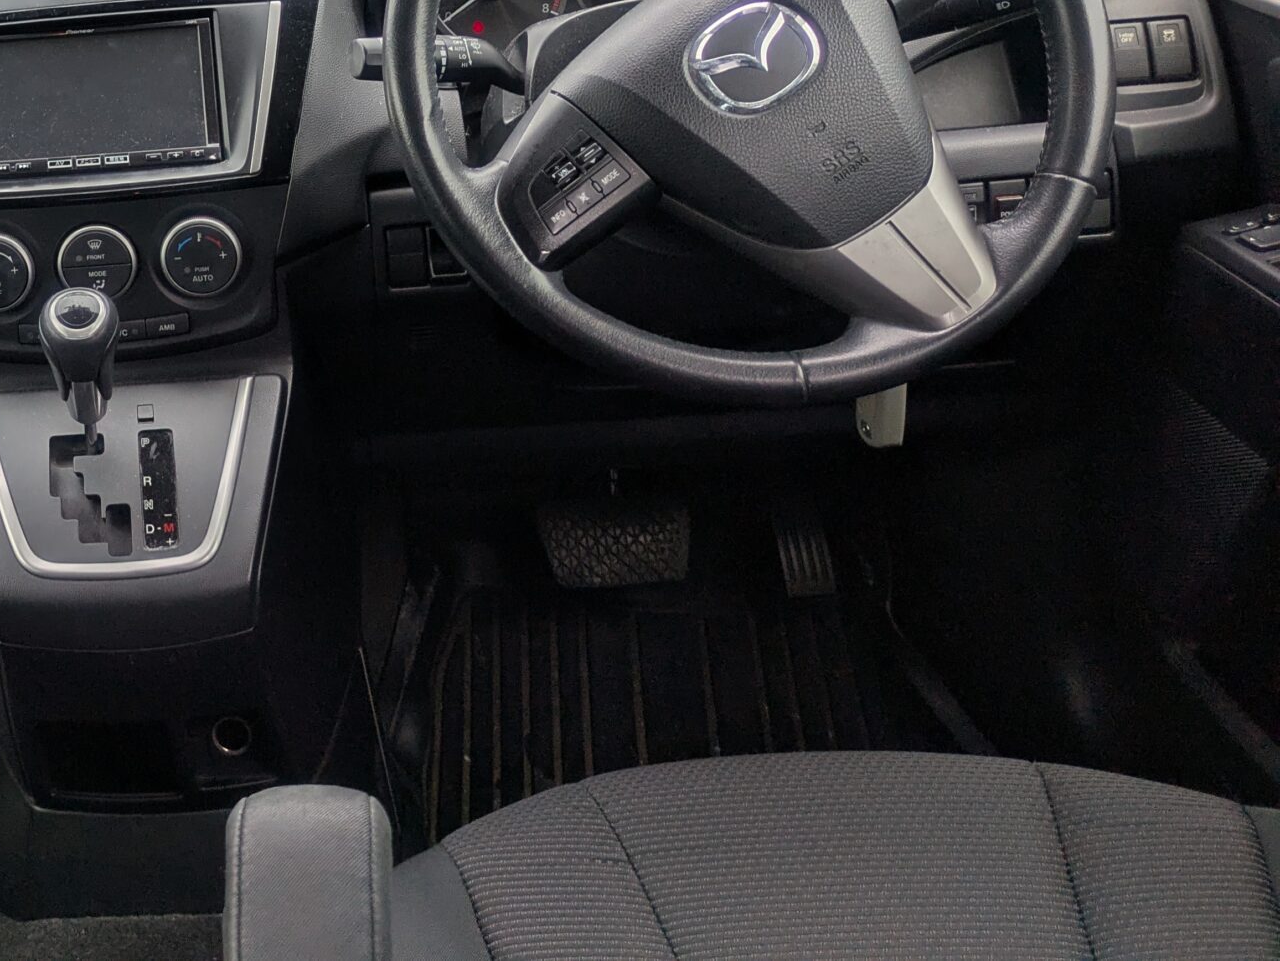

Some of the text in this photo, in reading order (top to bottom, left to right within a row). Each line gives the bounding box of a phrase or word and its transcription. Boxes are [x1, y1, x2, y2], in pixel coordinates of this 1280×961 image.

[541, 3, 550, 13] 8
[822, 140, 861, 173] SRS
[832, 154, 870, 185] AIRBAG
[600, 168, 620, 186] MODE
[550, 209, 566, 224] INFO
[86, 253, 106, 261] FRONT
[88, 270, 107, 278] MODE
[192, 274, 214, 283] AUTO
[158, 323, 176, 332] AMB
[140, 437, 150, 448] P
[143, 475, 152, 487] R
[143, 499, 154, 510] N
